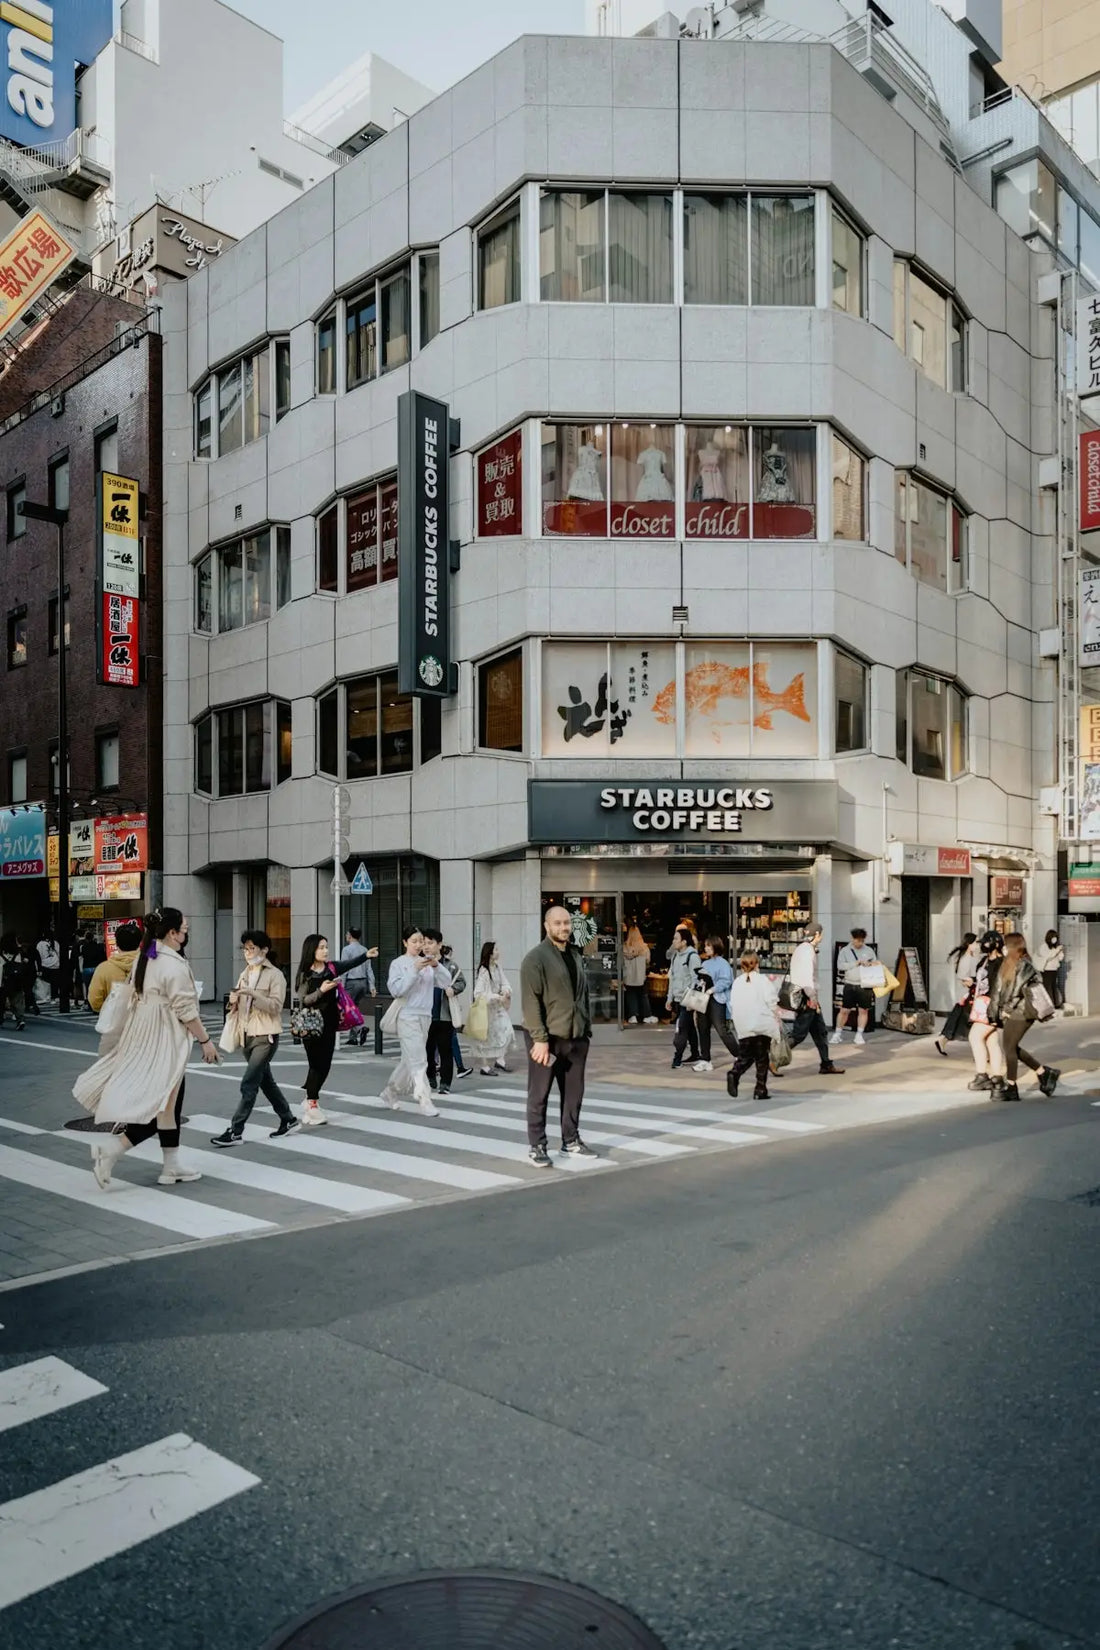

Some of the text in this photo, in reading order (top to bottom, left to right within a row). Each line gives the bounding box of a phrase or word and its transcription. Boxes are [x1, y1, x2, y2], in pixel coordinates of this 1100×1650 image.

[161, 217, 205, 251] Plaza
[484, 455, 514, 484] 販売
[494, 482, 506, 498] &
[424, 416, 438, 637] STARBUCKS COFFEE
[485, 499, 514, 525] 買取
[611, 506, 747, 536] closet child
[350, 537, 398, 575] 高額買
[600, 788, 771, 808] STARBUCKS
[633, 810, 740, 831] COFFEE
